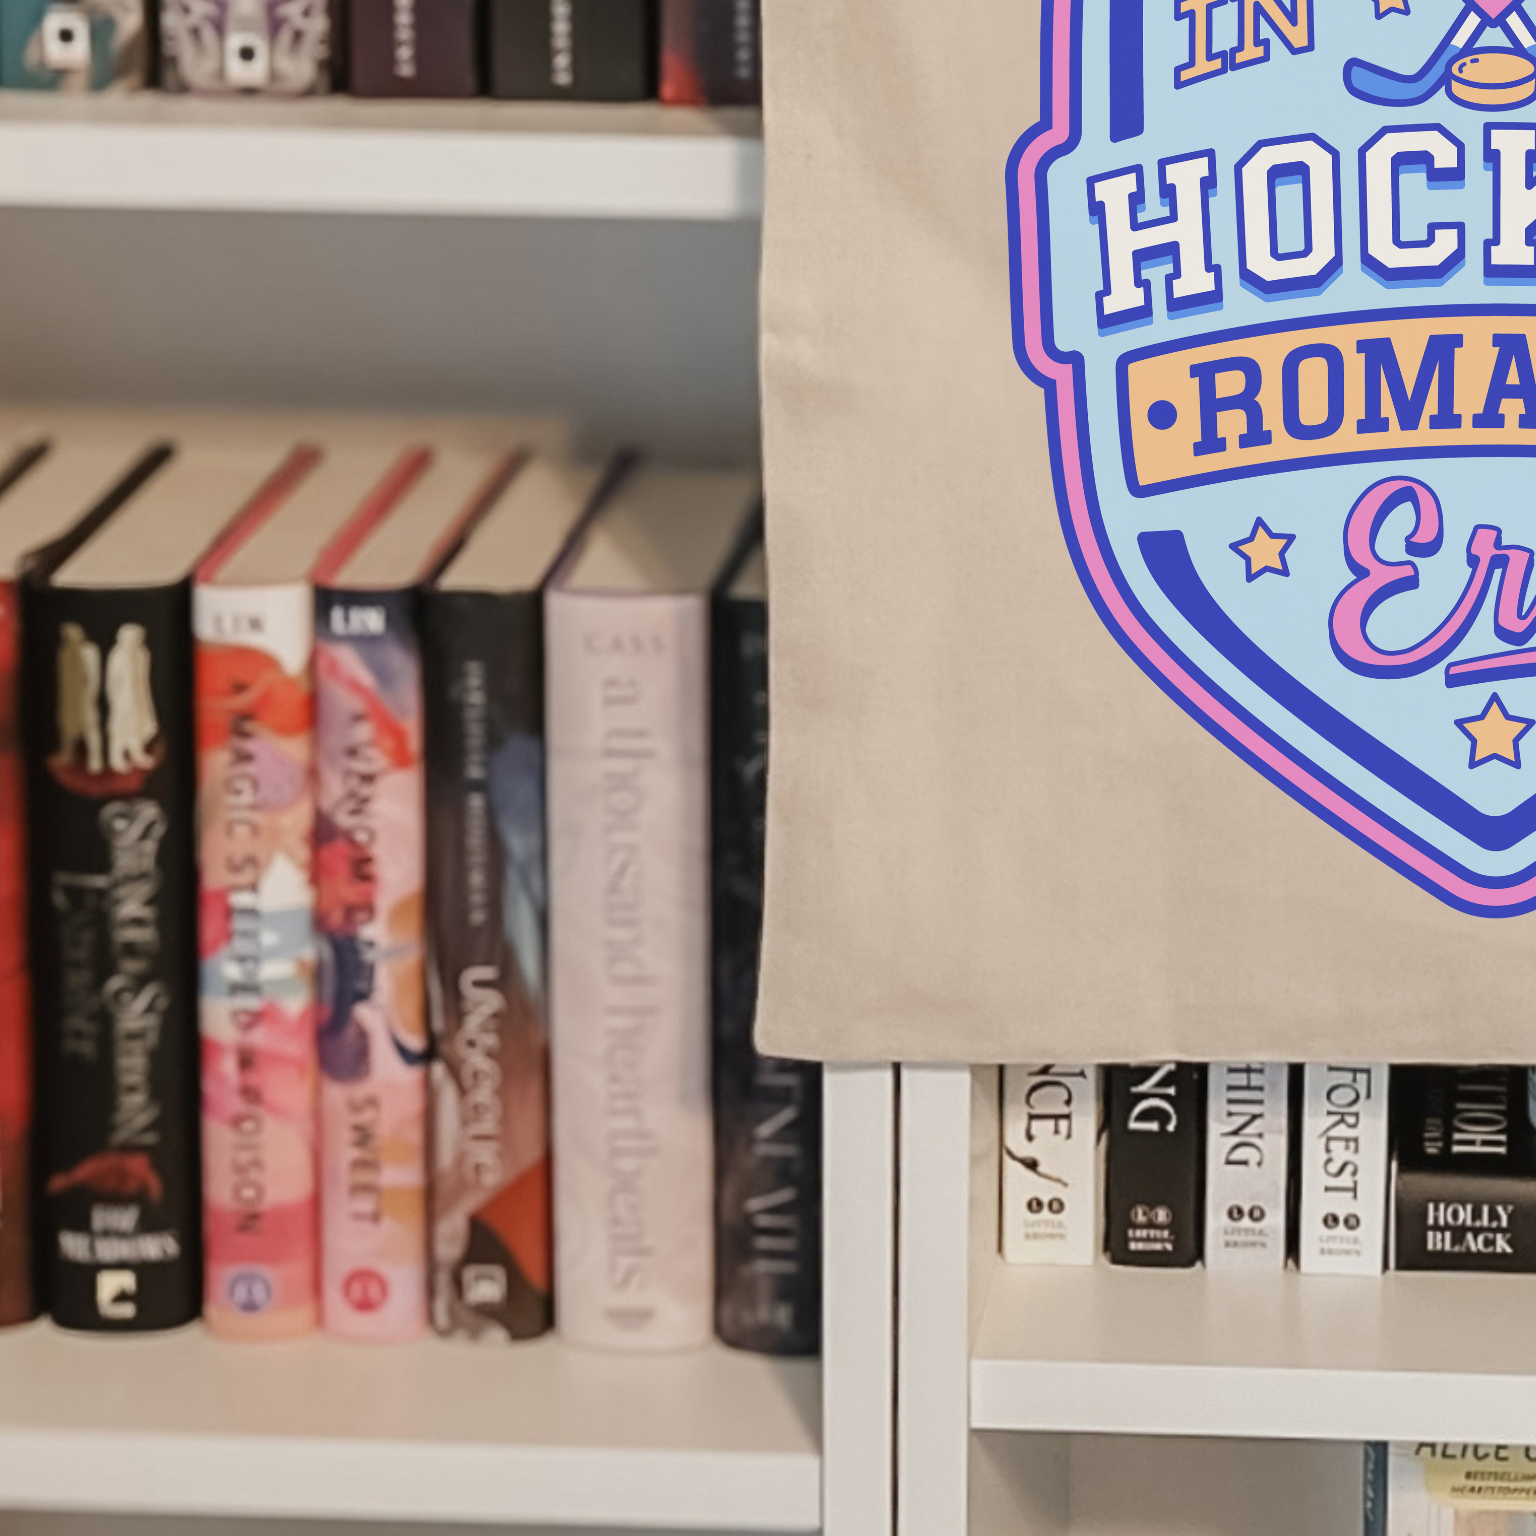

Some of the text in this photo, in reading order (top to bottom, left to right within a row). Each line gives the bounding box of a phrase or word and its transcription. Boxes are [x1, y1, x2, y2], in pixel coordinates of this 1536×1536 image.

[330, 606, 385, 637] LIN
[600, 726, 656, 987] thousand
[347, 1095, 381, 1225] SWEET
[605, 1004, 659, 1291] heartbeats
[1318, 1065, 1372, 1200] FOREST
[1427, 1202, 1515, 1229] HOLLY
[1427, 1231, 1514, 1254] BLACK
